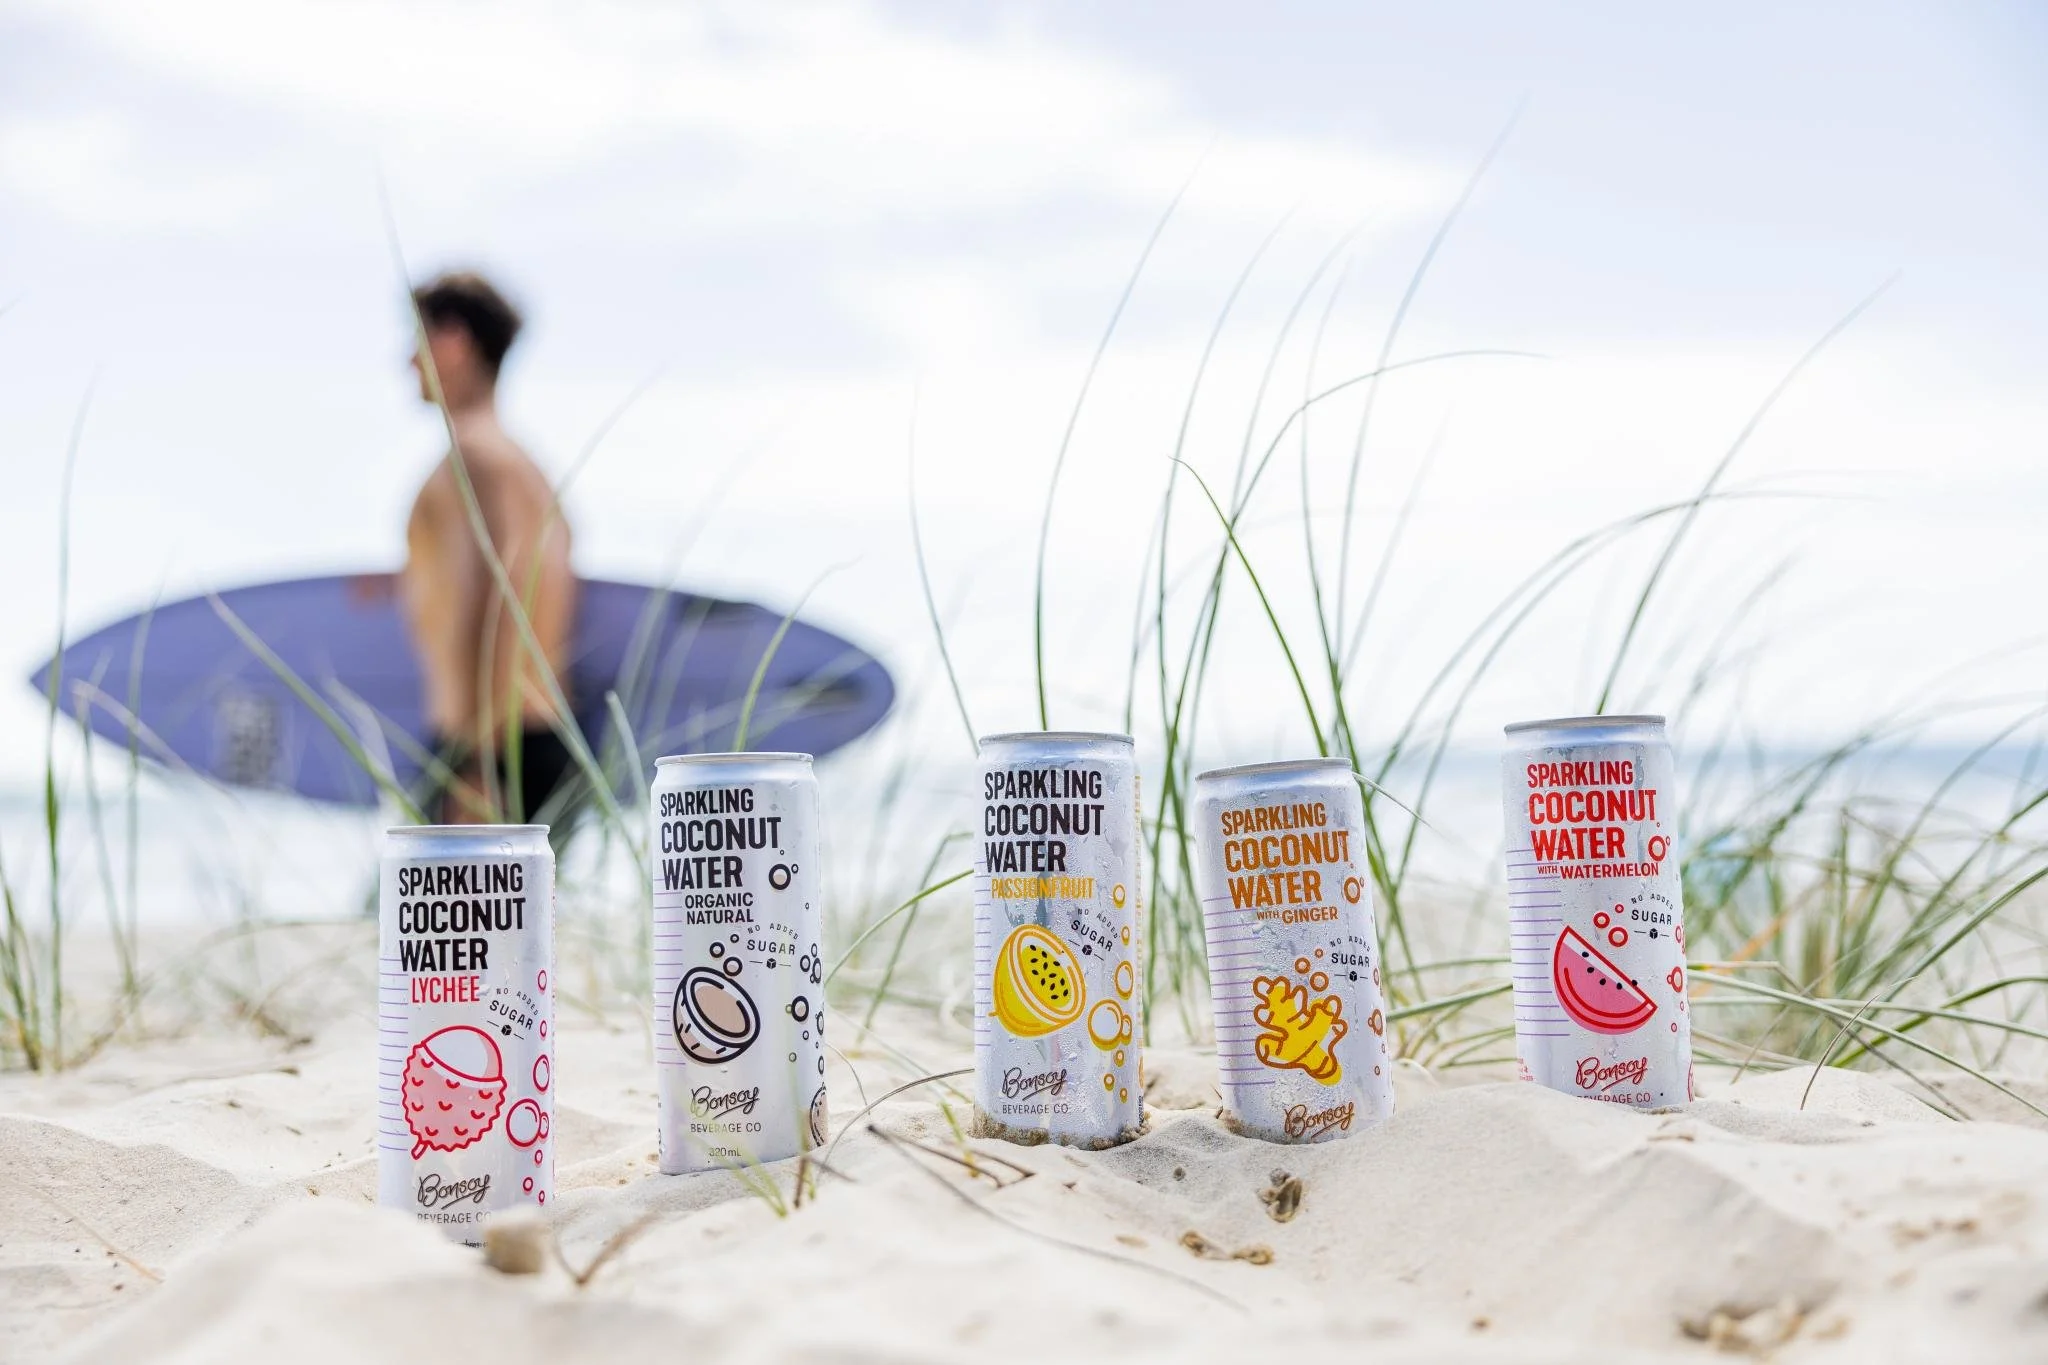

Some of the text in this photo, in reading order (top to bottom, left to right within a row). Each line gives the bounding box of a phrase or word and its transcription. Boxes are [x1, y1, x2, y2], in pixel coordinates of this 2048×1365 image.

[984, 769, 1102, 800] SPARKLING
[1527, 760, 1634, 788] SPARKLING
[660, 788, 754, 817] SPARKLING
[1529, 789, 1657, 825] COCONUT
[661, 816, 781, 853] COCONUT
[984, 803, 1105, 836] COCONUT
[1221, 802, 1327, 836] SPARKLING
[984, 840, 1067, 873] WATER
[1224, 830, 1349, 873] COCONUT
[1530, 826, 1626, 861] WATER
[399, 863, 523, 897] SPARKLING
[662, 855, 743, 891] WATER
[1537, 862, 1659, 879] WITH WATERMELON
[684, 892, 754, 909] ORGANIC
[991, 876, 1095, 899] PASSIONFRUIT
[1227, 869, 1323, 909] WATER
[1631, 893, 1673, 910] NO ADDED
[399, 897, 526, 934] COCONUT
[686, 909, 754, 925] NATURAL
[1077, 908, 1119, 939] NO ADDED
[1256, 906, 1339, 924] WITH GINGER
[1631, 909, 1672, 926] SUGAR
[747, 922, 799, 940] NO ADDED
[1071, 920, 1113, 952] SUGAR
[1329, 935, 1371, 952] NO ADDED
[399, 938, 488, 972] WATER
[746, 939, 796, 955] SUGAR
[1331, 952, 1370, 967] SUGAR
[412, 975, 480, 1004] LYCHEE
[516, 991, 539, 1016] ADDED
[489, 1000, 534, 1031] SUGAR
[1001, 1067, 1067, 1101] Bonsoy
[1575, 1056, 1648, 1092] Bonsoy
[690, 1085, 760, 1120] Bonsoy
[1002, 1103, 1069, 1114] BEVERAGE CO
[1636, 1092, 1651, 1103] CO
[690, 1122, 762, 1133] BEVERAGE CO
[1284, 1101, 1355, 1139] Bonsoy
[417, 1173, 490, 1210] Bonsoy
